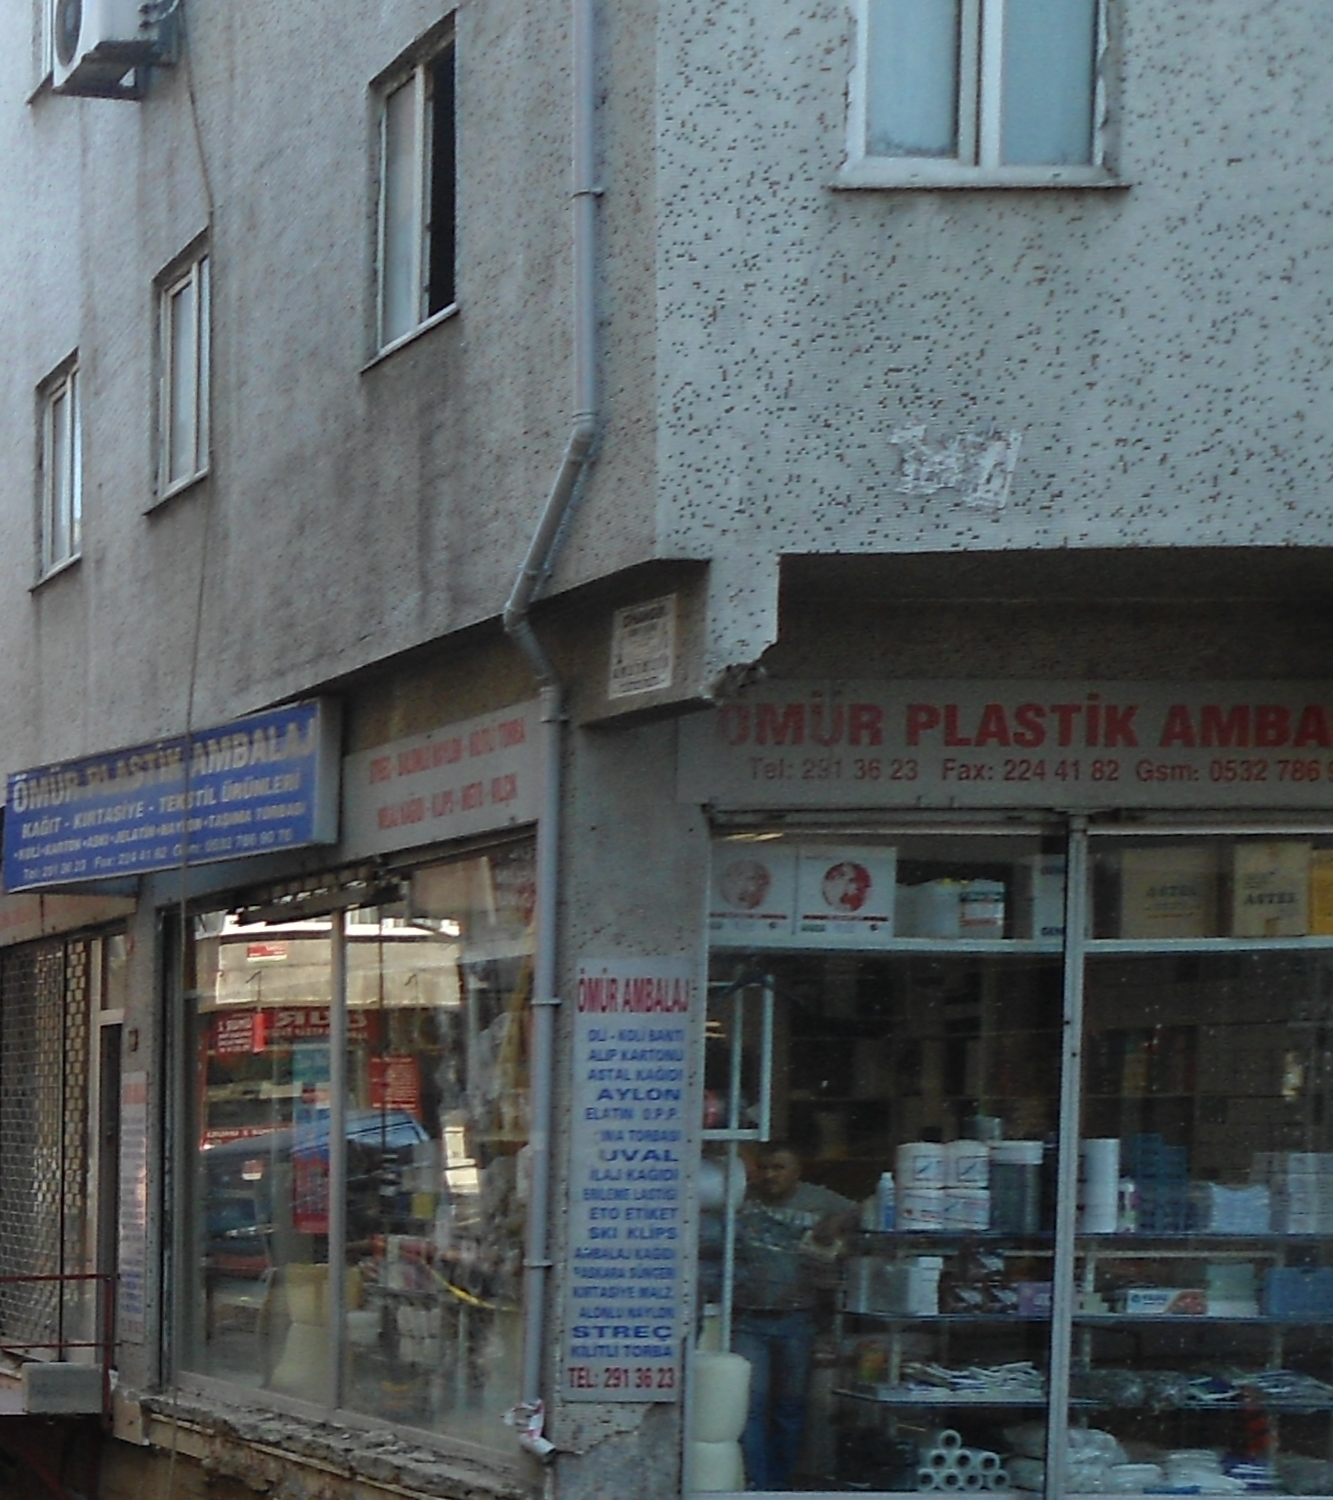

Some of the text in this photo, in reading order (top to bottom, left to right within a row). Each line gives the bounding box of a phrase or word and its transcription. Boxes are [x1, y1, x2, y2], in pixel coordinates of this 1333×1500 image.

[905, 692, 1140, 748] PLASTİK
[1159, 703, 1333, 748] AMBA
[191, 717, 317, 776] AMBALAJ
[749, 757, 794, 781] Tel:
[853, 757, 881, 781] 36
[890, 758, 919, 781] 23
[941, 757, 994, 781] Fax:
[1003, 758, 1047, 781] 224
[1054, 758, 1081, 781] 41
[1091, 758, 1120, 782] 82
[1136, 758, 1199, 782] Gsm:
[1209, 758, 1269, 782] 0532
[1276, 758, 1321, 782] 786
[22, 814, 62, 840] KAĞIT
[73, 799, 145, 831] KIRTASİYE
[577, 967, 689, 1013] ÖMÜR AMBALAJ
[621, 1048, 685, 1062] KARTONU
[572, 1325, 673, 1342] STREÇ
[622, 1344, 672, 1357] TORBA
[567, 1366, 676, 1389] TEL: 291 36 23
